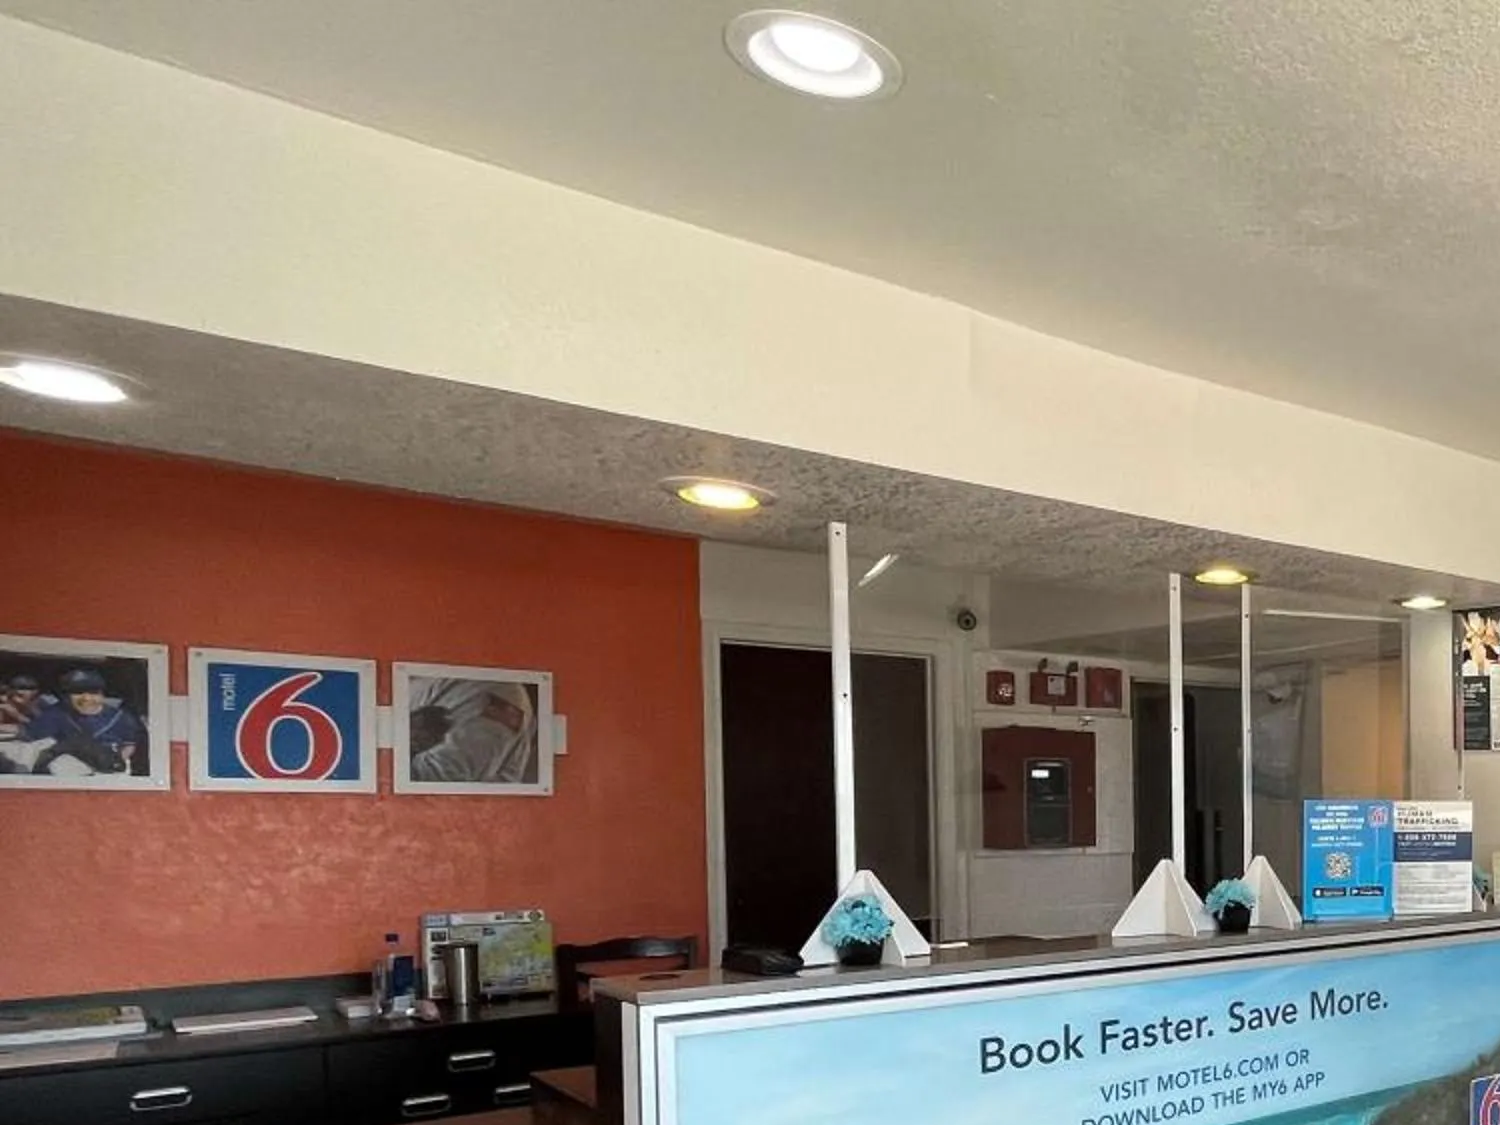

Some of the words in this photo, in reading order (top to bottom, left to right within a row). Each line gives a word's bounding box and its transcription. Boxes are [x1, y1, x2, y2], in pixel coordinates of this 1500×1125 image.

[235, 671, 343, 782] 6
[1397, 817, 1459, 825] TRAFFICKING
[980, 1023, 1085, 1074] Book
[1100, 1014, 1214, 1054] Faster.
[1228, 1001, 1298, 1034] Save
[1310, 988, 1389, 1020] More.
[1101, 1077, 1148, 1103] VISIT
[1157, 1053, 1279, 1093] MOTEL6.COM
[1285, 1048, 1311, 1068] OR
[1211, 1086, 1245, 1110] THE
[1252, 1080, 1288, 1102] MY6
[1294, 1071, 1326, 1092] APP
